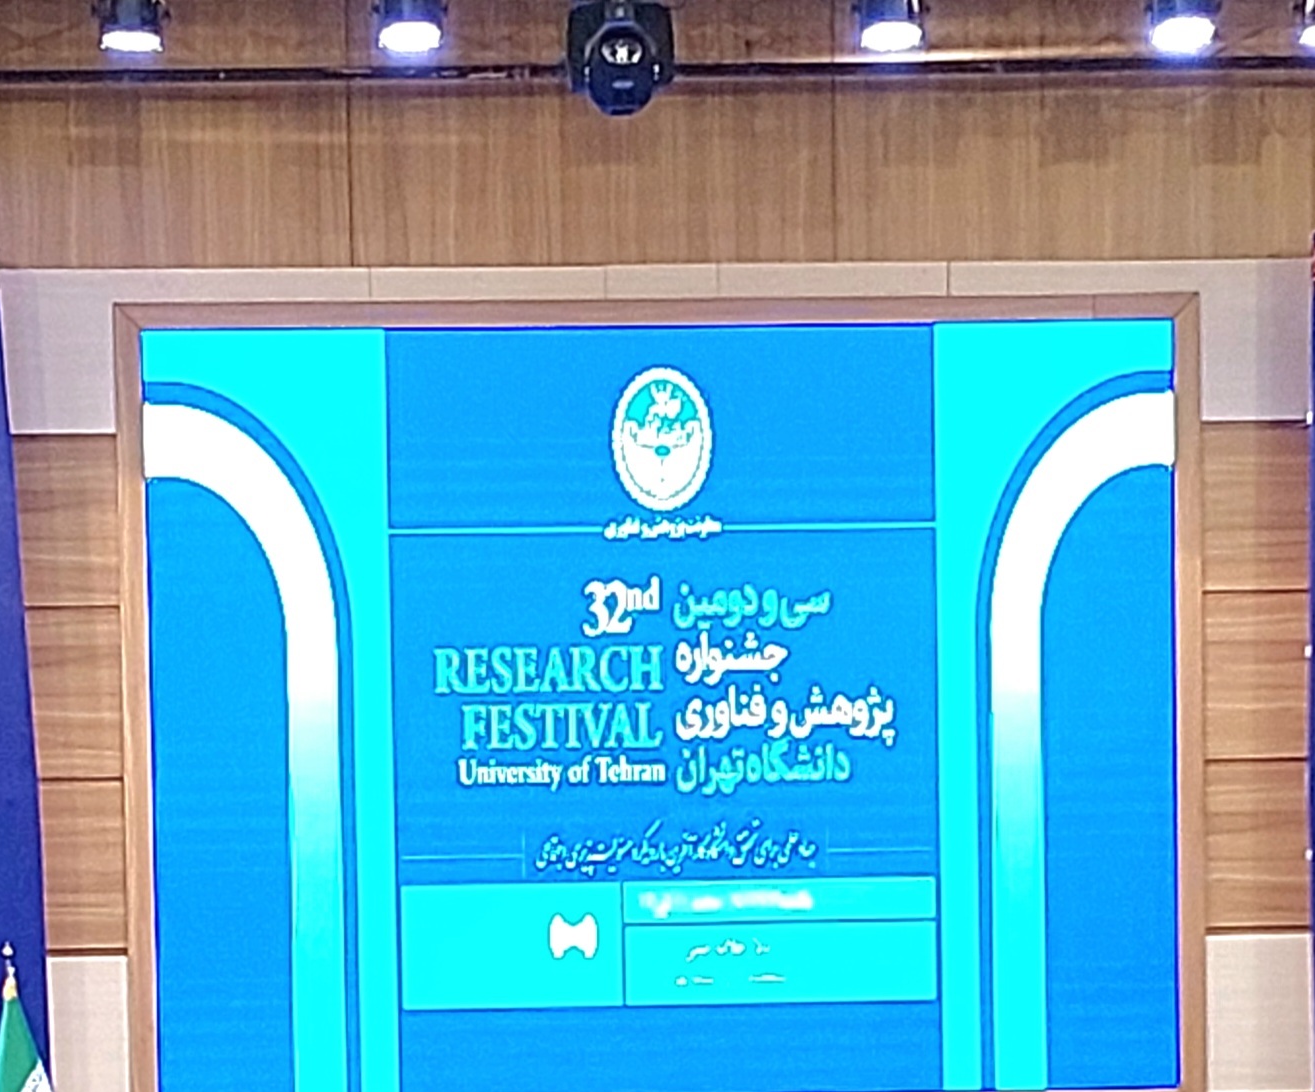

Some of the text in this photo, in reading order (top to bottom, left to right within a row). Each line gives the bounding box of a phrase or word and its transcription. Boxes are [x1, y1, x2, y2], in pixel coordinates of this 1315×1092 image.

[582, 576, 660, 637] 32nd
[673, 583, 831, 629] سی و دومین
[434, 644, 664, 693] RESEARCH
[676, 630, 788, 685] جشنواره
[461, 702, 663, 750] FESTIVAL
[676, 684, 895, 746] پژوهش و فناوری
[458, 754, 666, 791] University of Tehran
[676, 736, 851, 795] دانشگاه تهران
